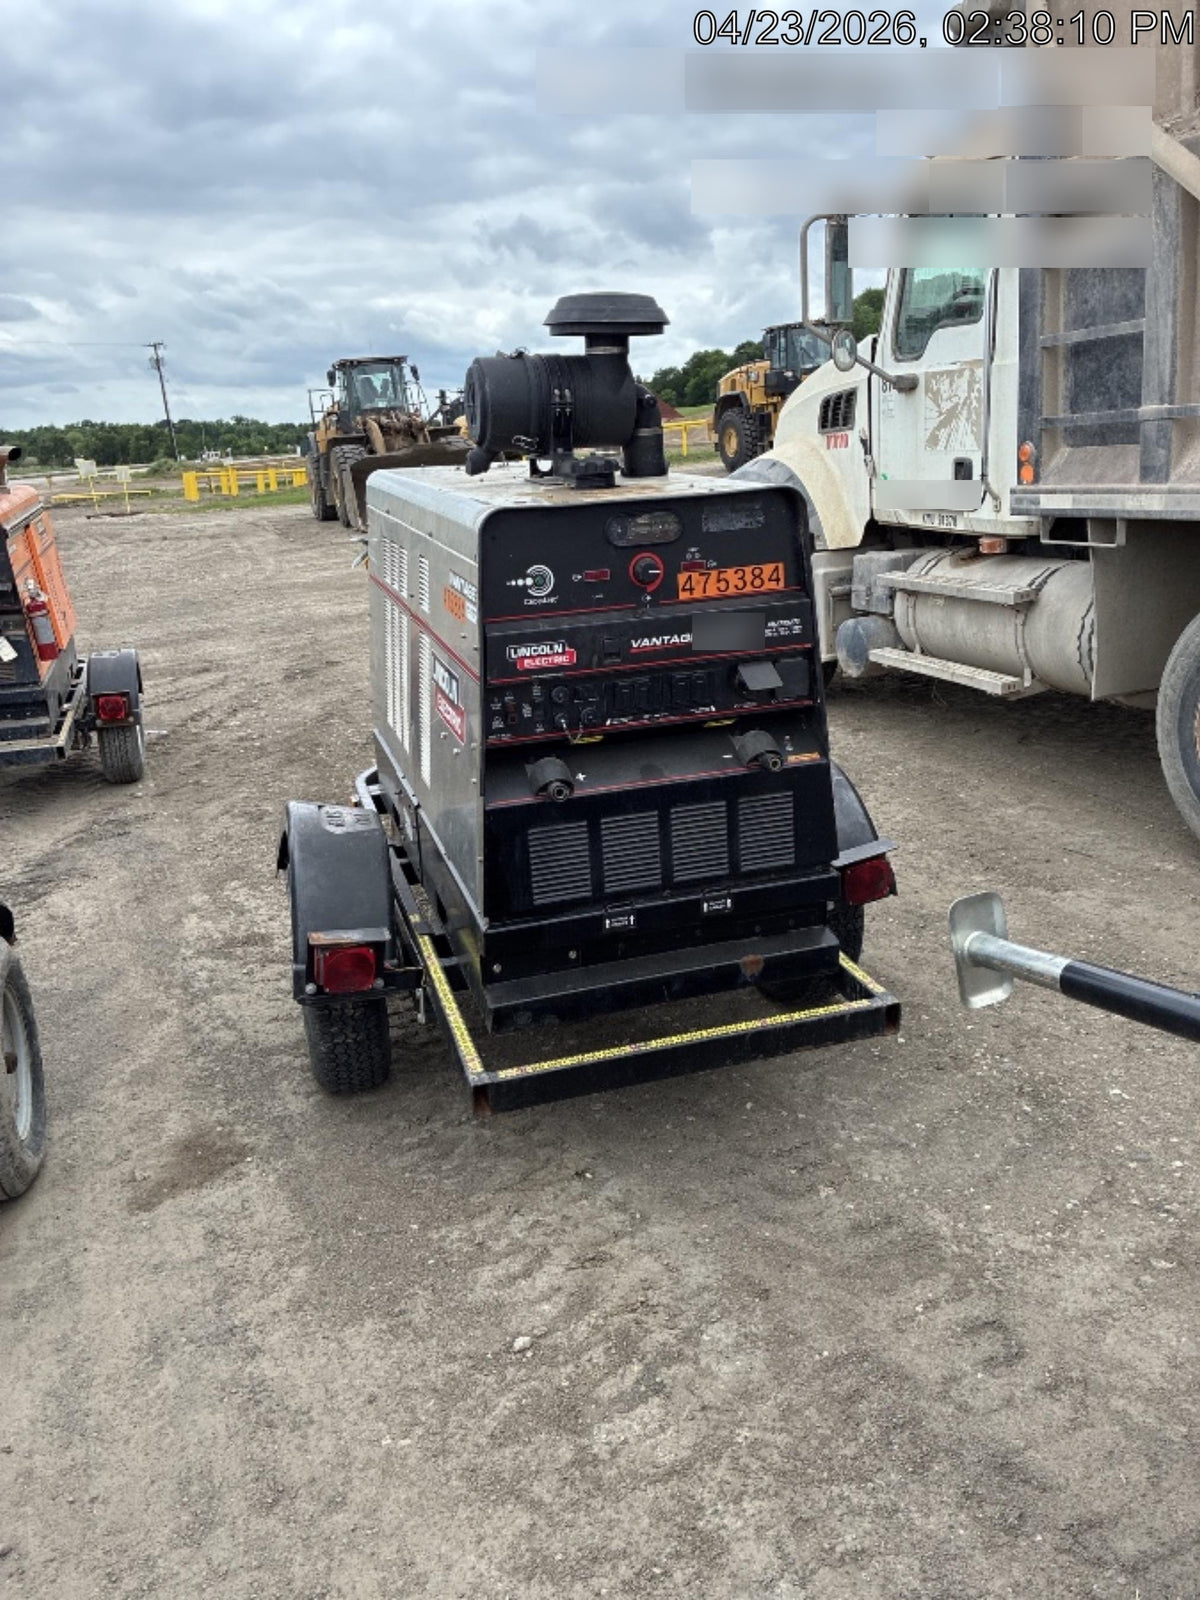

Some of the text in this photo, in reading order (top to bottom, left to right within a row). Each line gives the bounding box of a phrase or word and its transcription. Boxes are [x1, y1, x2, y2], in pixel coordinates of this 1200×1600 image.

[681, 565, 781, 596] 475384
[630, 632, 693, 649] VANTAG
[510, 643, 563, 659] LINCOLN
[523, 654, 570, 667] ELECTRIC
